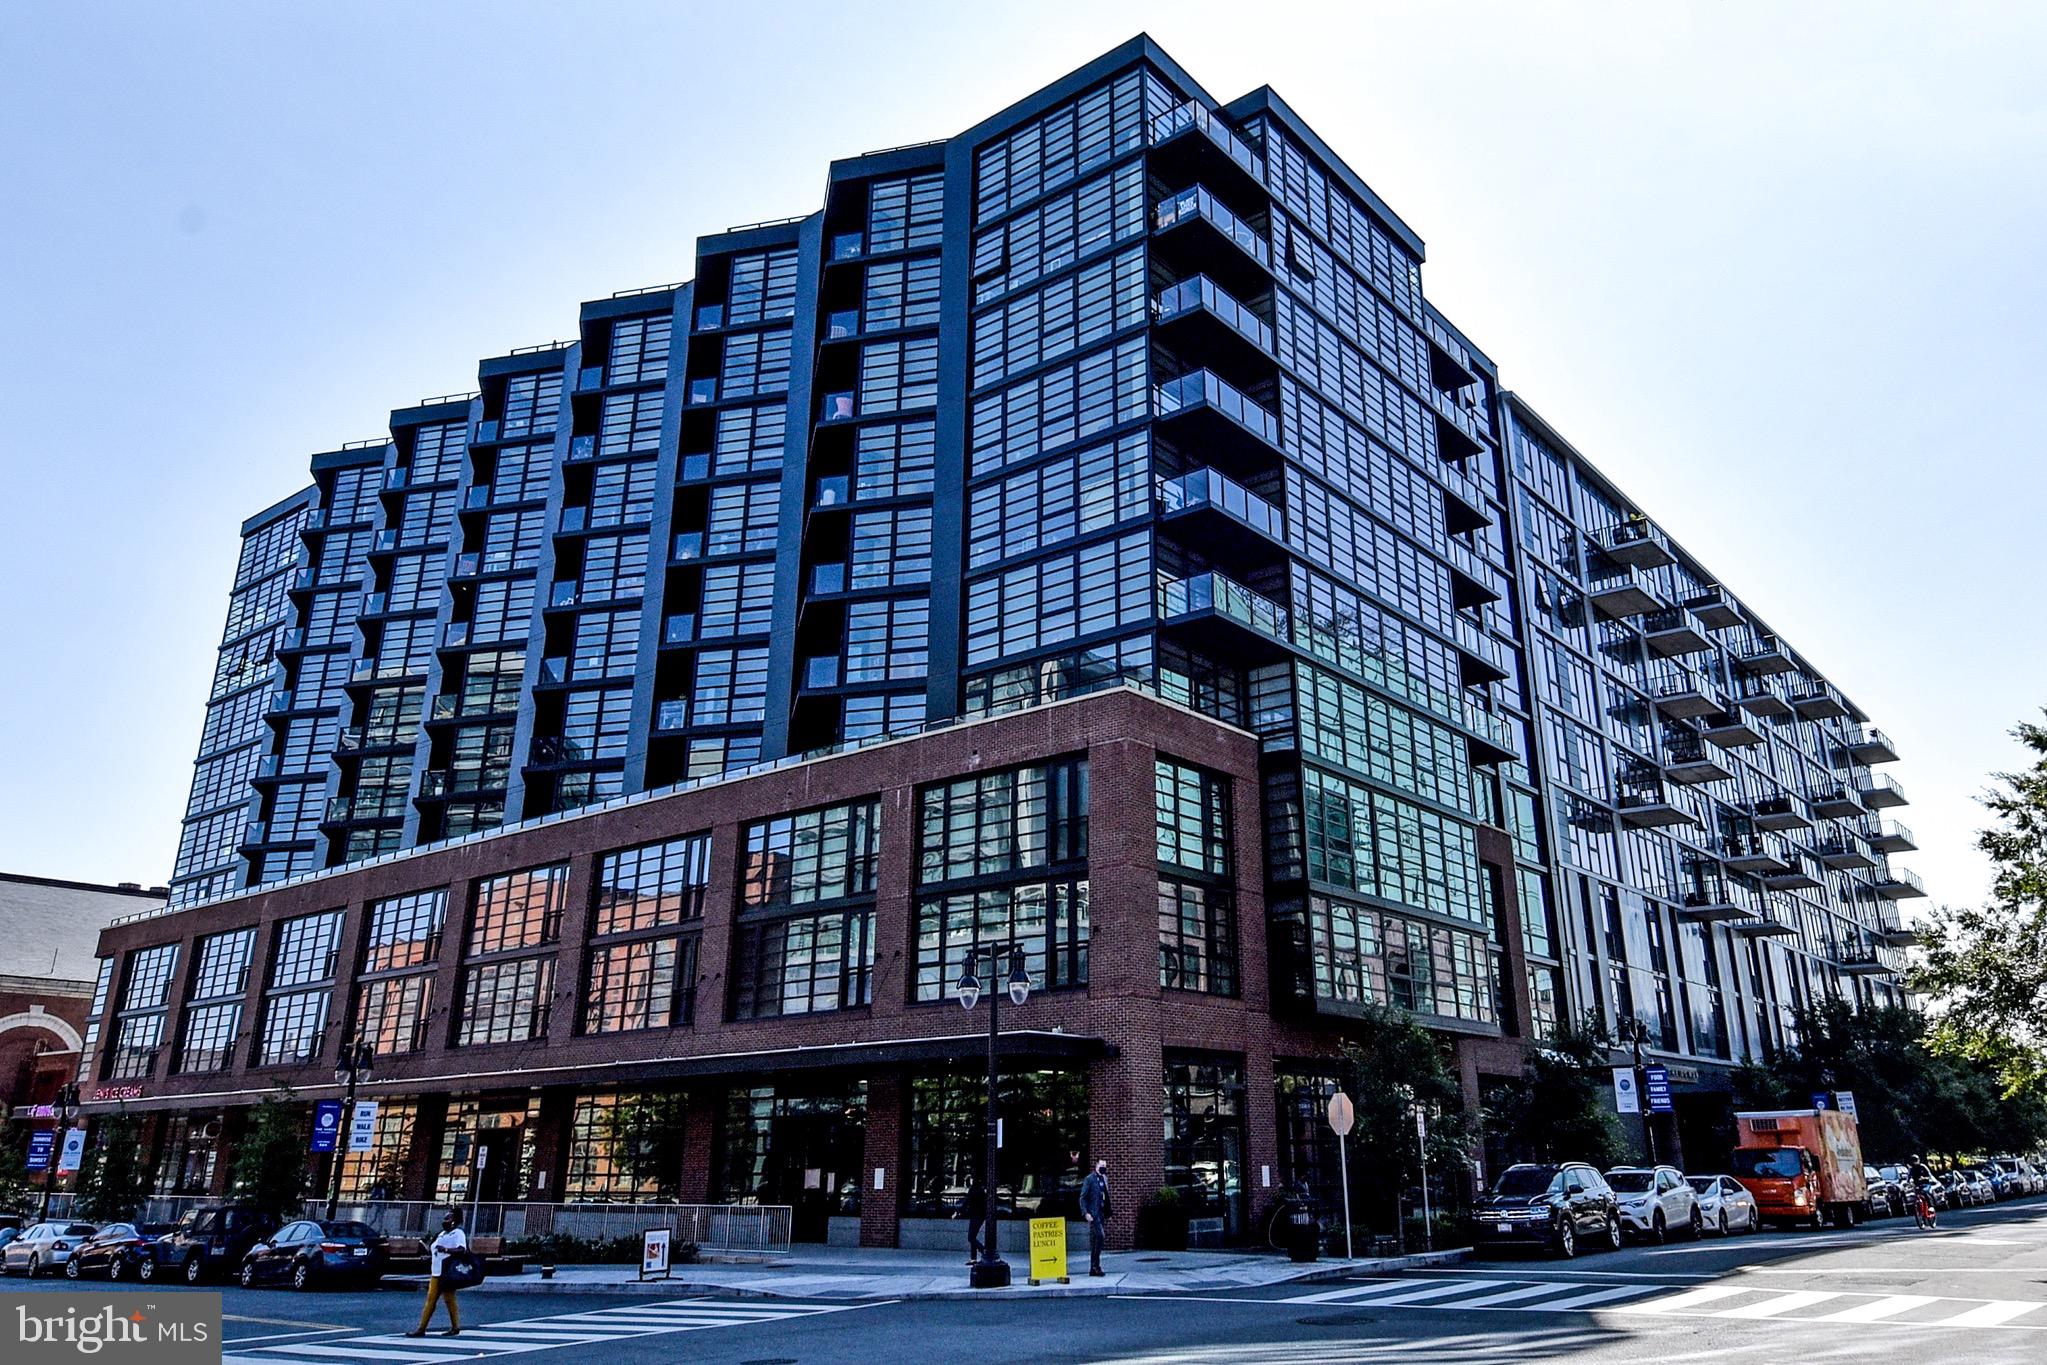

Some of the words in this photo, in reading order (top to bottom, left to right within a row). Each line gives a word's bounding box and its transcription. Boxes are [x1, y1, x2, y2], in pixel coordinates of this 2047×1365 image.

[1032, 1222, 1058, 1230] COFFEE
[1033, 1230, 1063, 1239] PASTRIES
[1033, 1239, 1056, 1247] LUNCH
